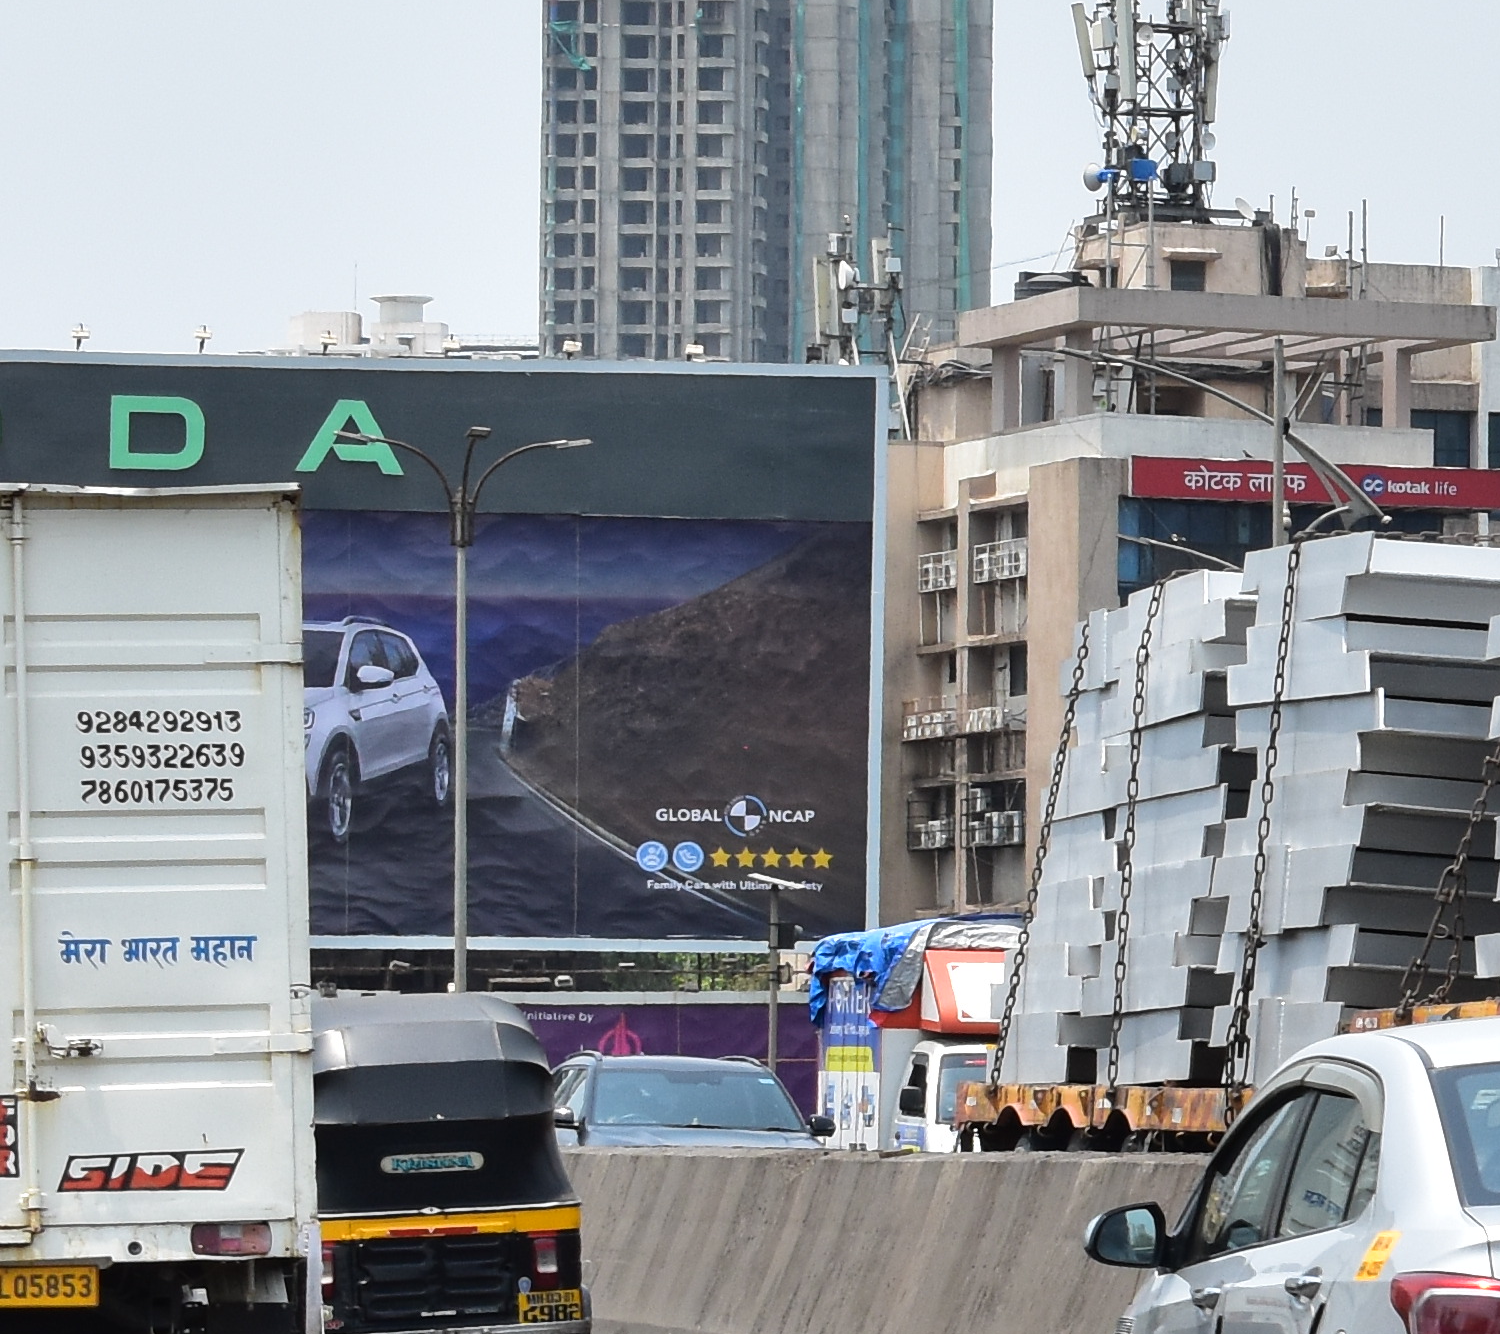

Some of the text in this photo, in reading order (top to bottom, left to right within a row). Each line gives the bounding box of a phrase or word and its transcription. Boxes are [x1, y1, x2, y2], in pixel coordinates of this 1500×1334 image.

[1184, 465, 1307, 493] कोटक लाफ
[1388, 480, 1457, 496] kotak life
[76, 710, 241, 733] 9284292913
[80, 742, 245, 769] 9359322639
[81, 778, 234, 804] 7860175375
[655, 808, 815, 823] GLOBAL NCAP
[647, 879, 682, 891] Family
[685, 880, 711, 890] Care
[713, 880, 737, 890] with
[58, 930, 257, 969] मेरा भारत महान
[579, 1012, 594, 1023] by
[60, 1152, 240, 1189] SIDE
